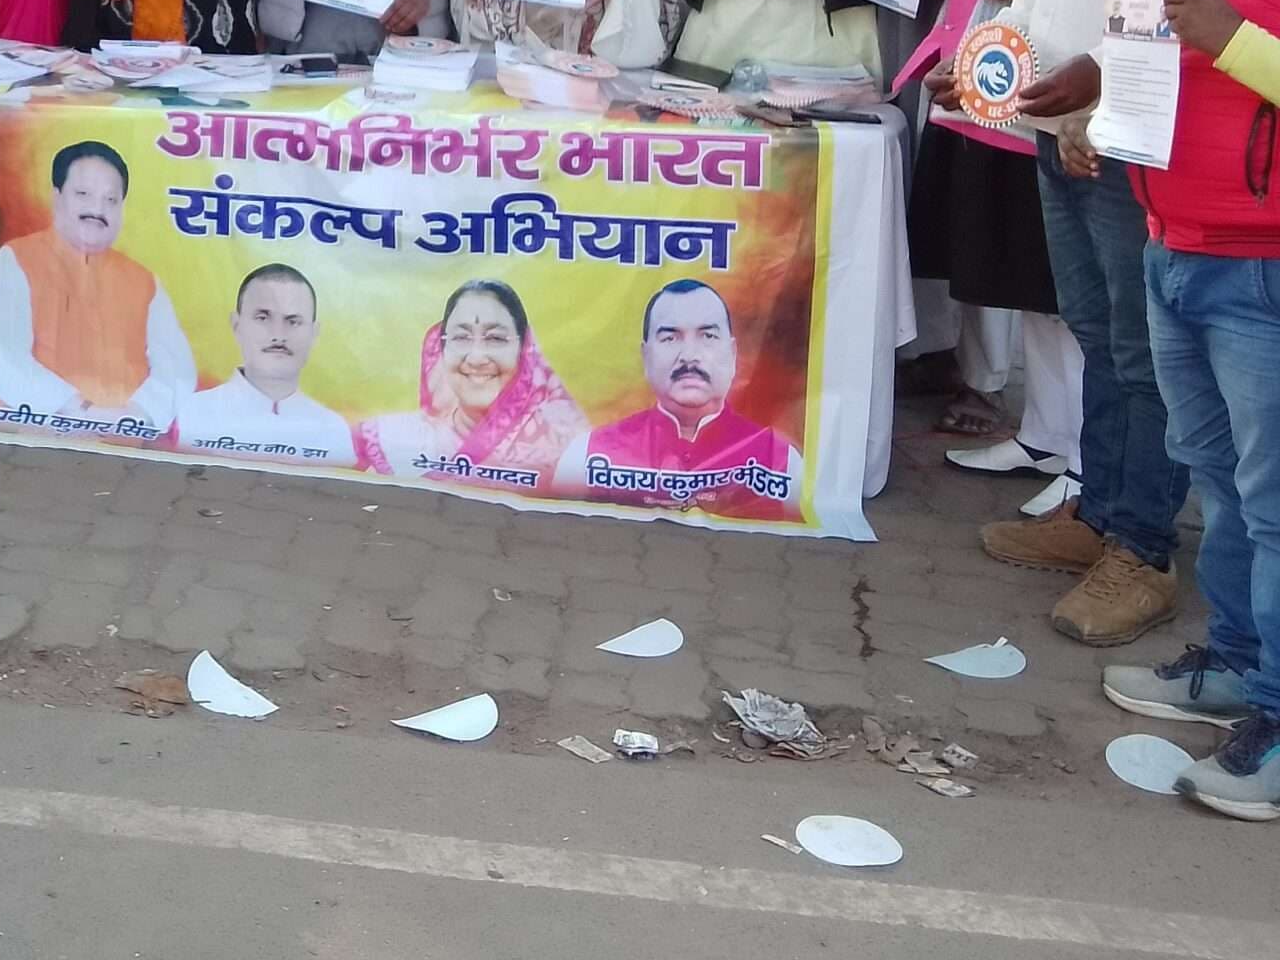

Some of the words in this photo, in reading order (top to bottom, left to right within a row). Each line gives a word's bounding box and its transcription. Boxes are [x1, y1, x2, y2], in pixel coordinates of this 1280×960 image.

[157, 111, 549, 180] आत्मनिर्भर
[559, 130, 770, 187] भारत
[169, 173, 403, 248] संकल्प
[414, 192, 736, 270] अभियान
[50, 414, 111, 434] कुमार
[115, 416, 160, 440] सिंह
[475, 466, 538, 487] यादव
[587, 455, 658, 491] विजय
[659, 467, 731, 499] कुमार
[735, 458, 792, 499] मंडल
